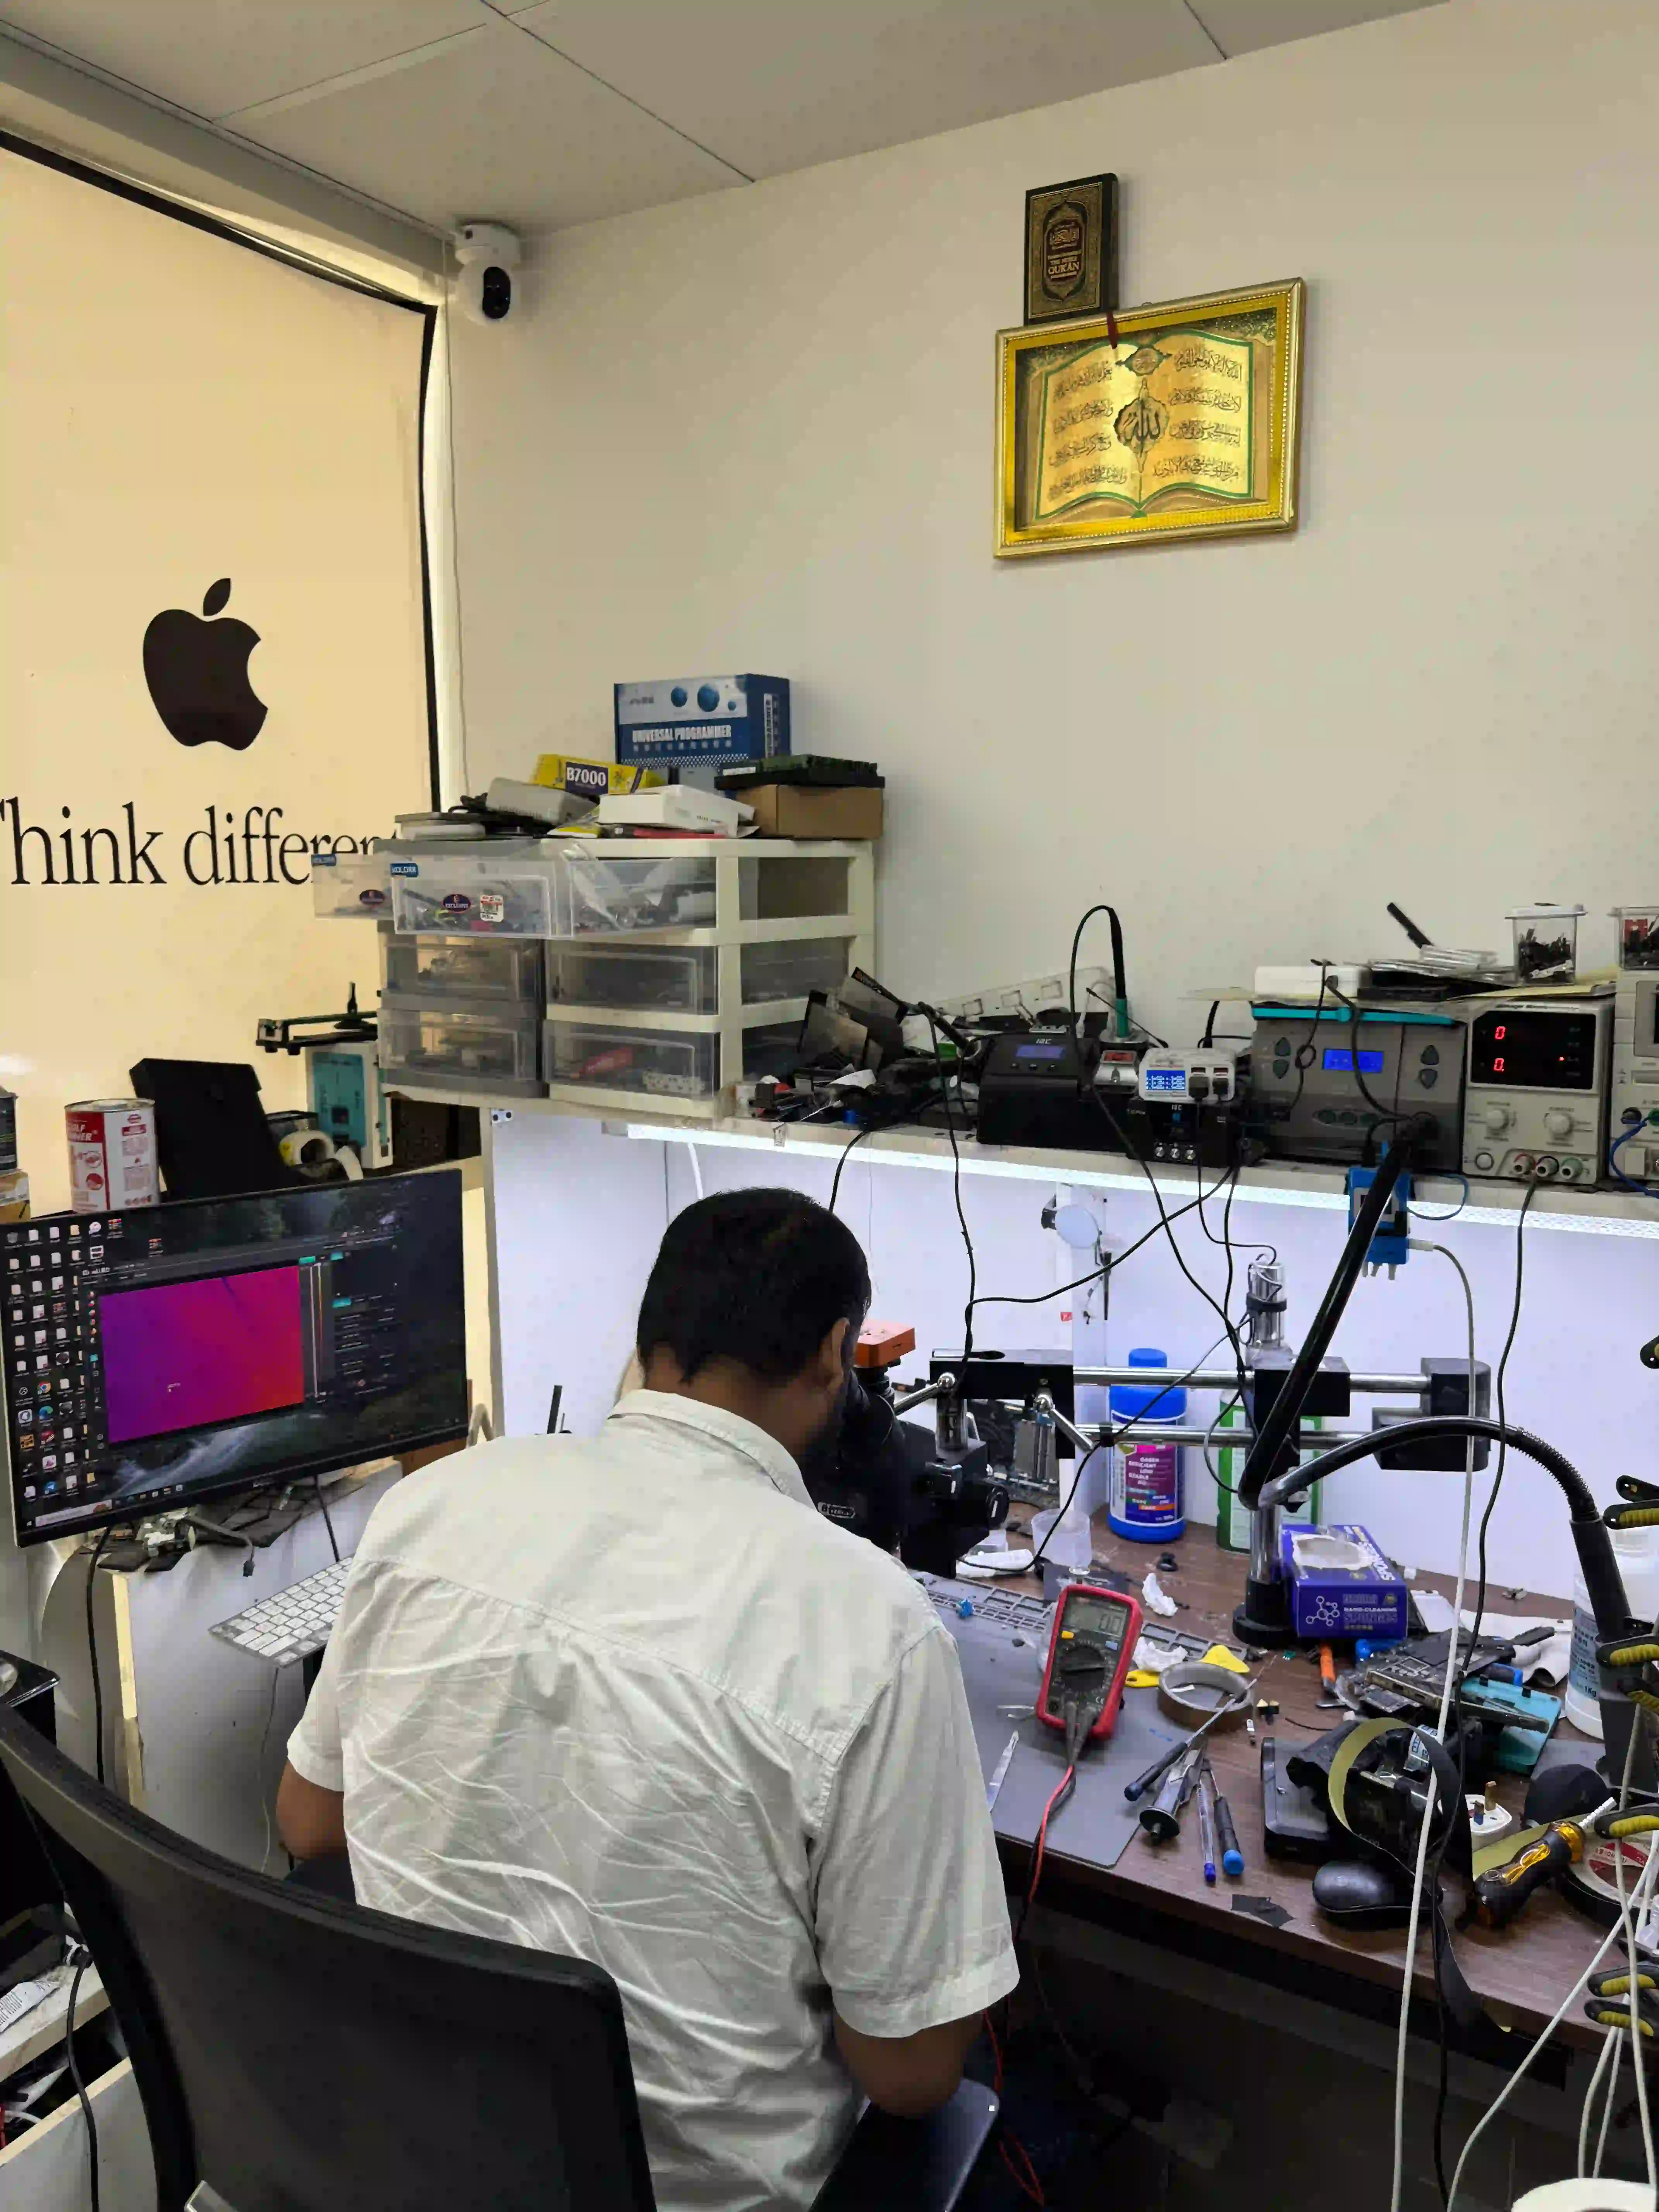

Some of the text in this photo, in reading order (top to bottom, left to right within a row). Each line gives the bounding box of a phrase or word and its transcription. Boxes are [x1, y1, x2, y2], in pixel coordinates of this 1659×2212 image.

[632, 725, 732, 743] UNIVERSAL PROGRAMMER
[567, 767, 606, 786] B7000
[0, 797, 396, 885] hink differe
[1495, 1026, 1506, 1039] 0
